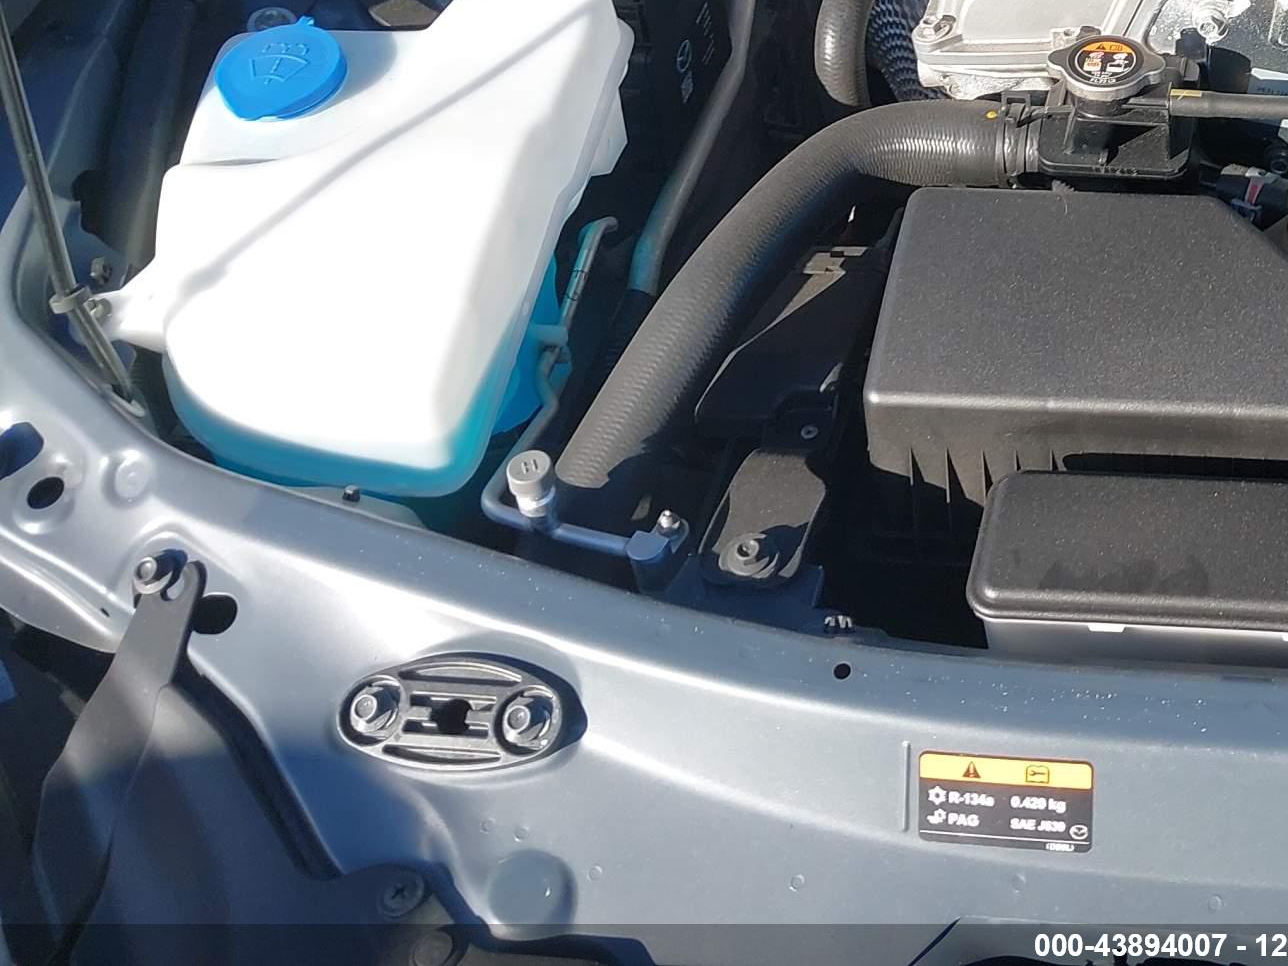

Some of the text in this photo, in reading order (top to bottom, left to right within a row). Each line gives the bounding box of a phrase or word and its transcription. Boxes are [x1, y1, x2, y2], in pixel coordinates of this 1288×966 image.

[948, 791, 1067, 814] R-134a 0.420 kg
[948, 813, 980, 827] PAG
[1009, 817, 1036, 831] SAE
